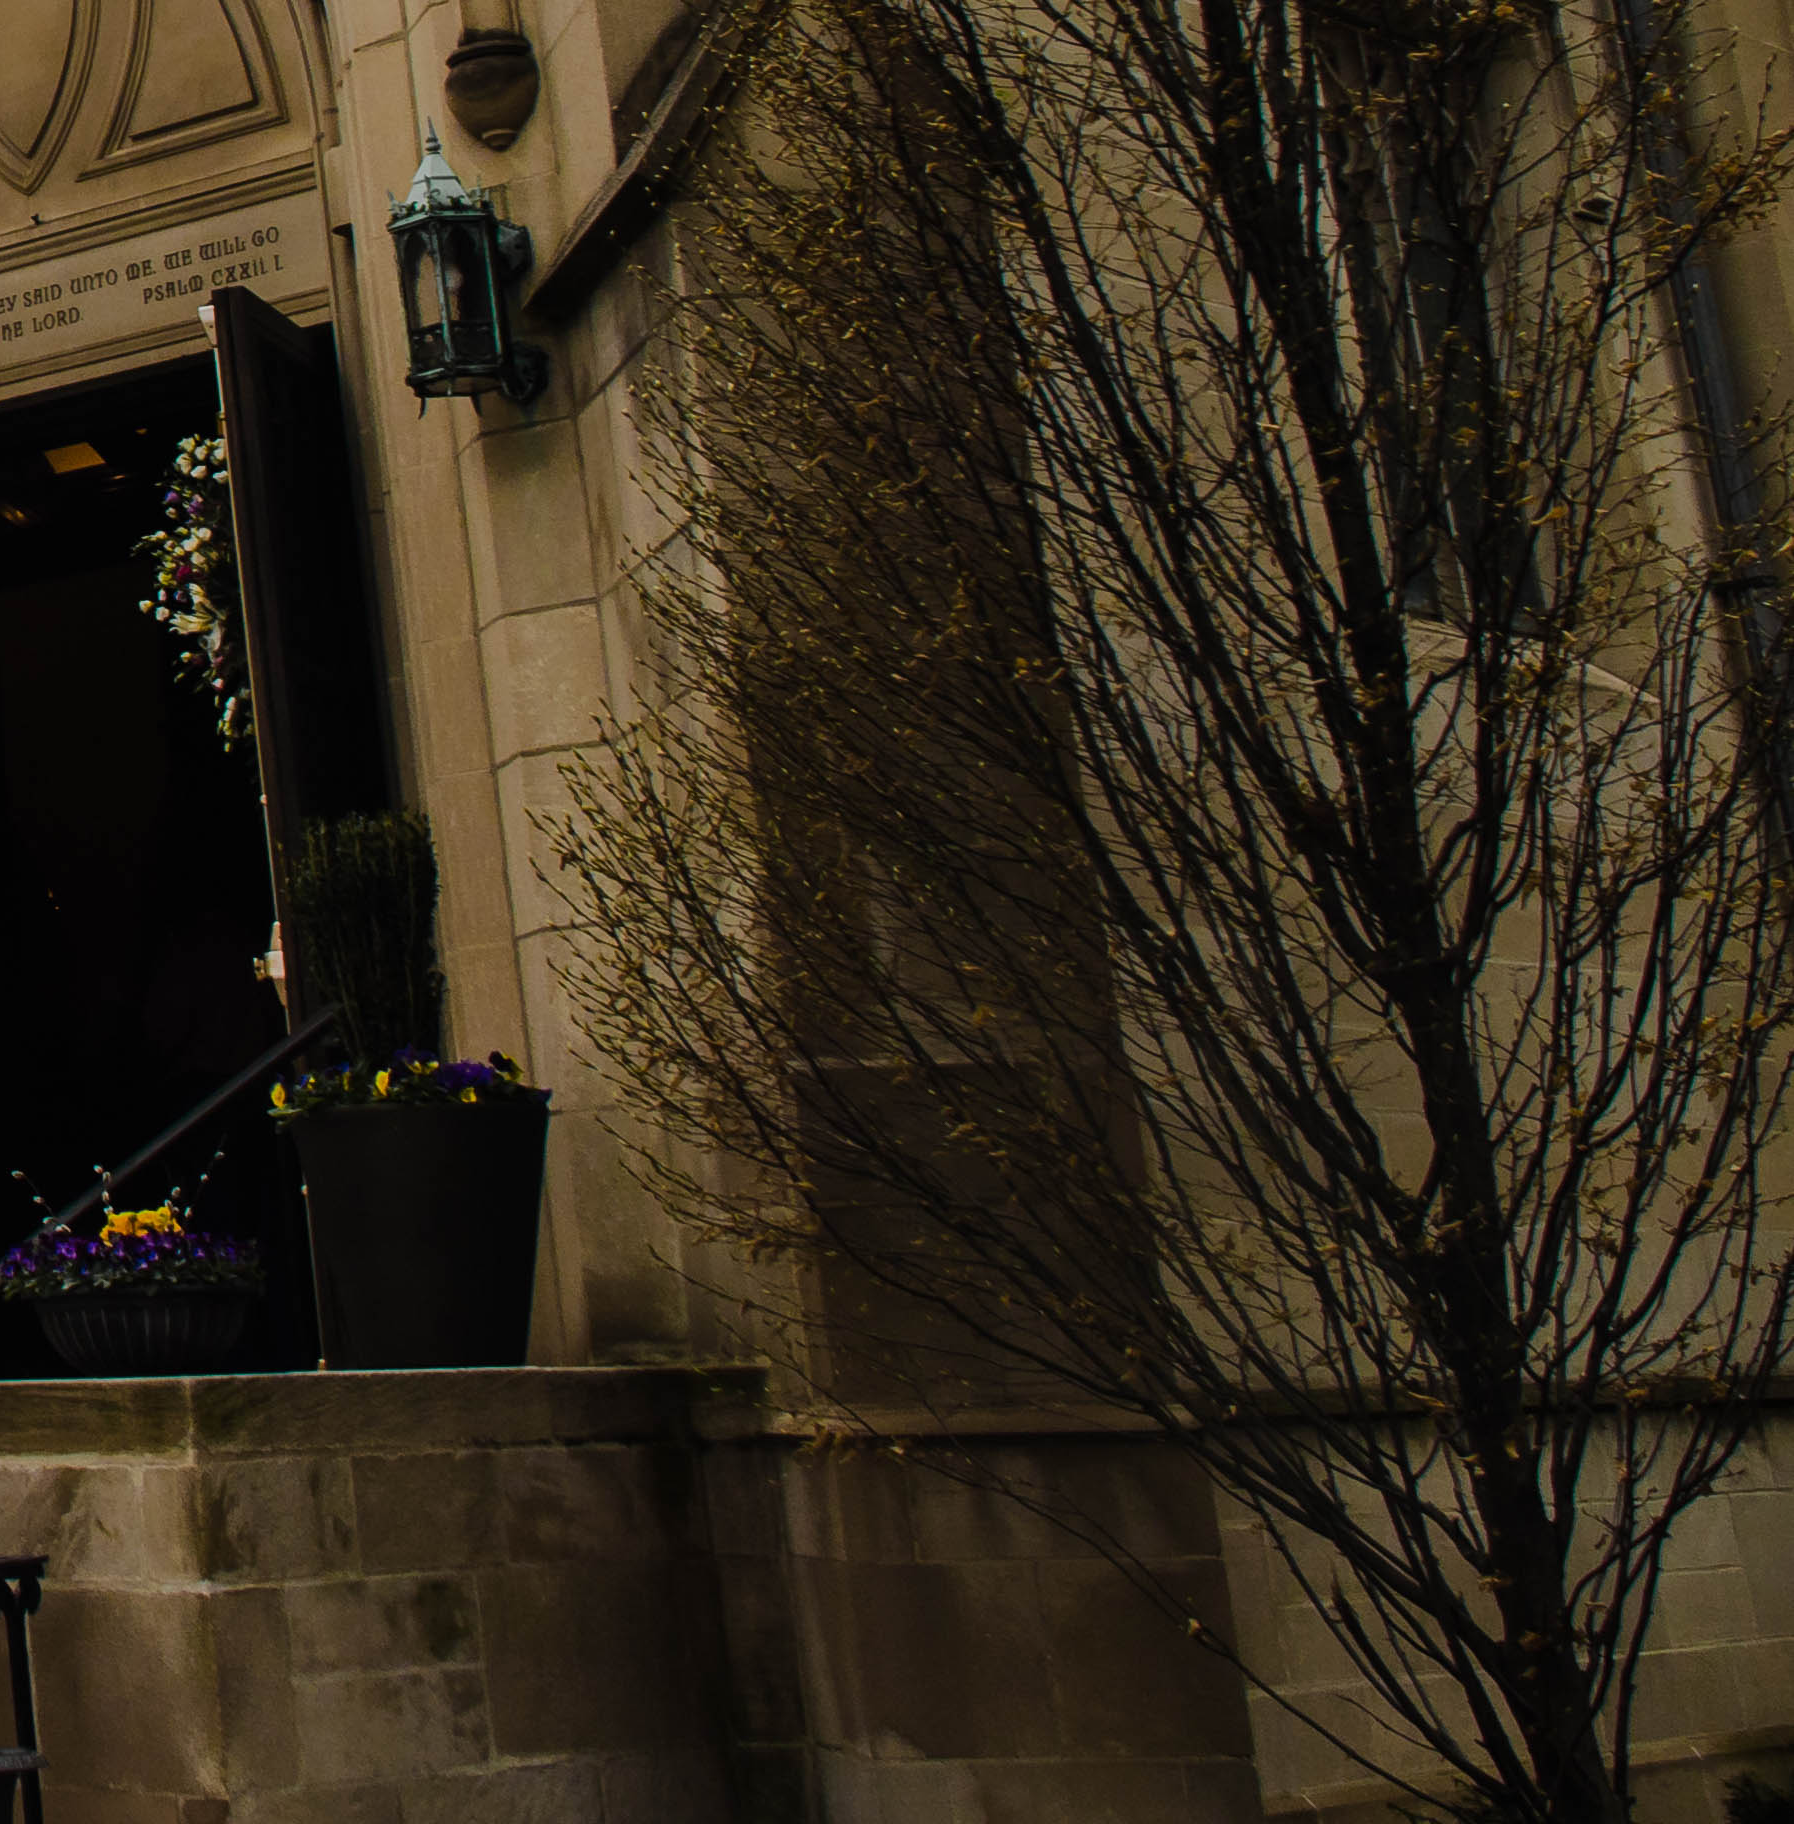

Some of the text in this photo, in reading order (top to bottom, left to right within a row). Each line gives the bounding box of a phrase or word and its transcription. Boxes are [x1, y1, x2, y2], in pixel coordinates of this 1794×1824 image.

[23, 284, 62, 308] SAID
[70, 269, 118, 294] UNTO
[164, 249, 193, 270] WE
[199, 236, 246, 261] WILL
[251, 226, 279, 247] GO
[143, 275, 203, 304] PSALM
[32, 307, 83, 332] LORD.
